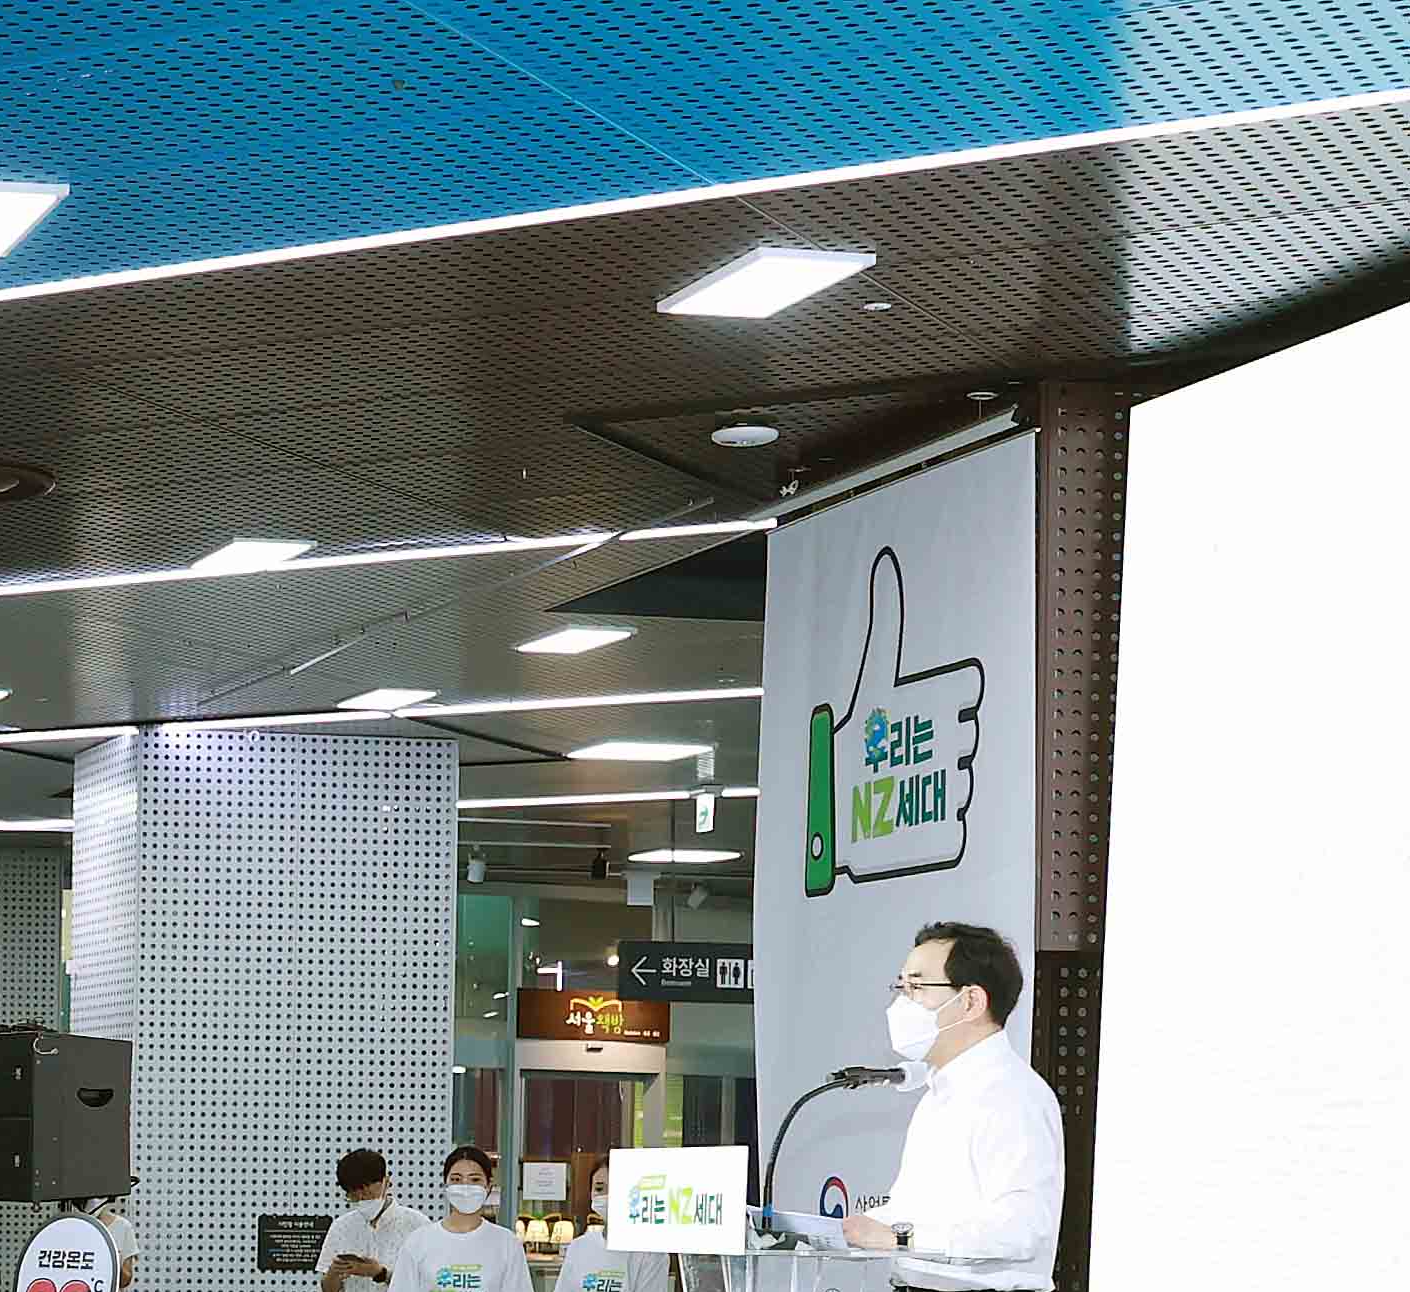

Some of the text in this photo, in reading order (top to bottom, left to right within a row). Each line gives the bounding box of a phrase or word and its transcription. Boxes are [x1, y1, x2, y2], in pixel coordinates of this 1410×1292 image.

[865, 708, 934, 773] 우리는
[851, 769, 946, 843] NZ세대
[661, 957, 710, 977] 화장실
[565, 1010, 624, 1035] 서울책방
[39, 1250, 95, 1270] 건강온도
